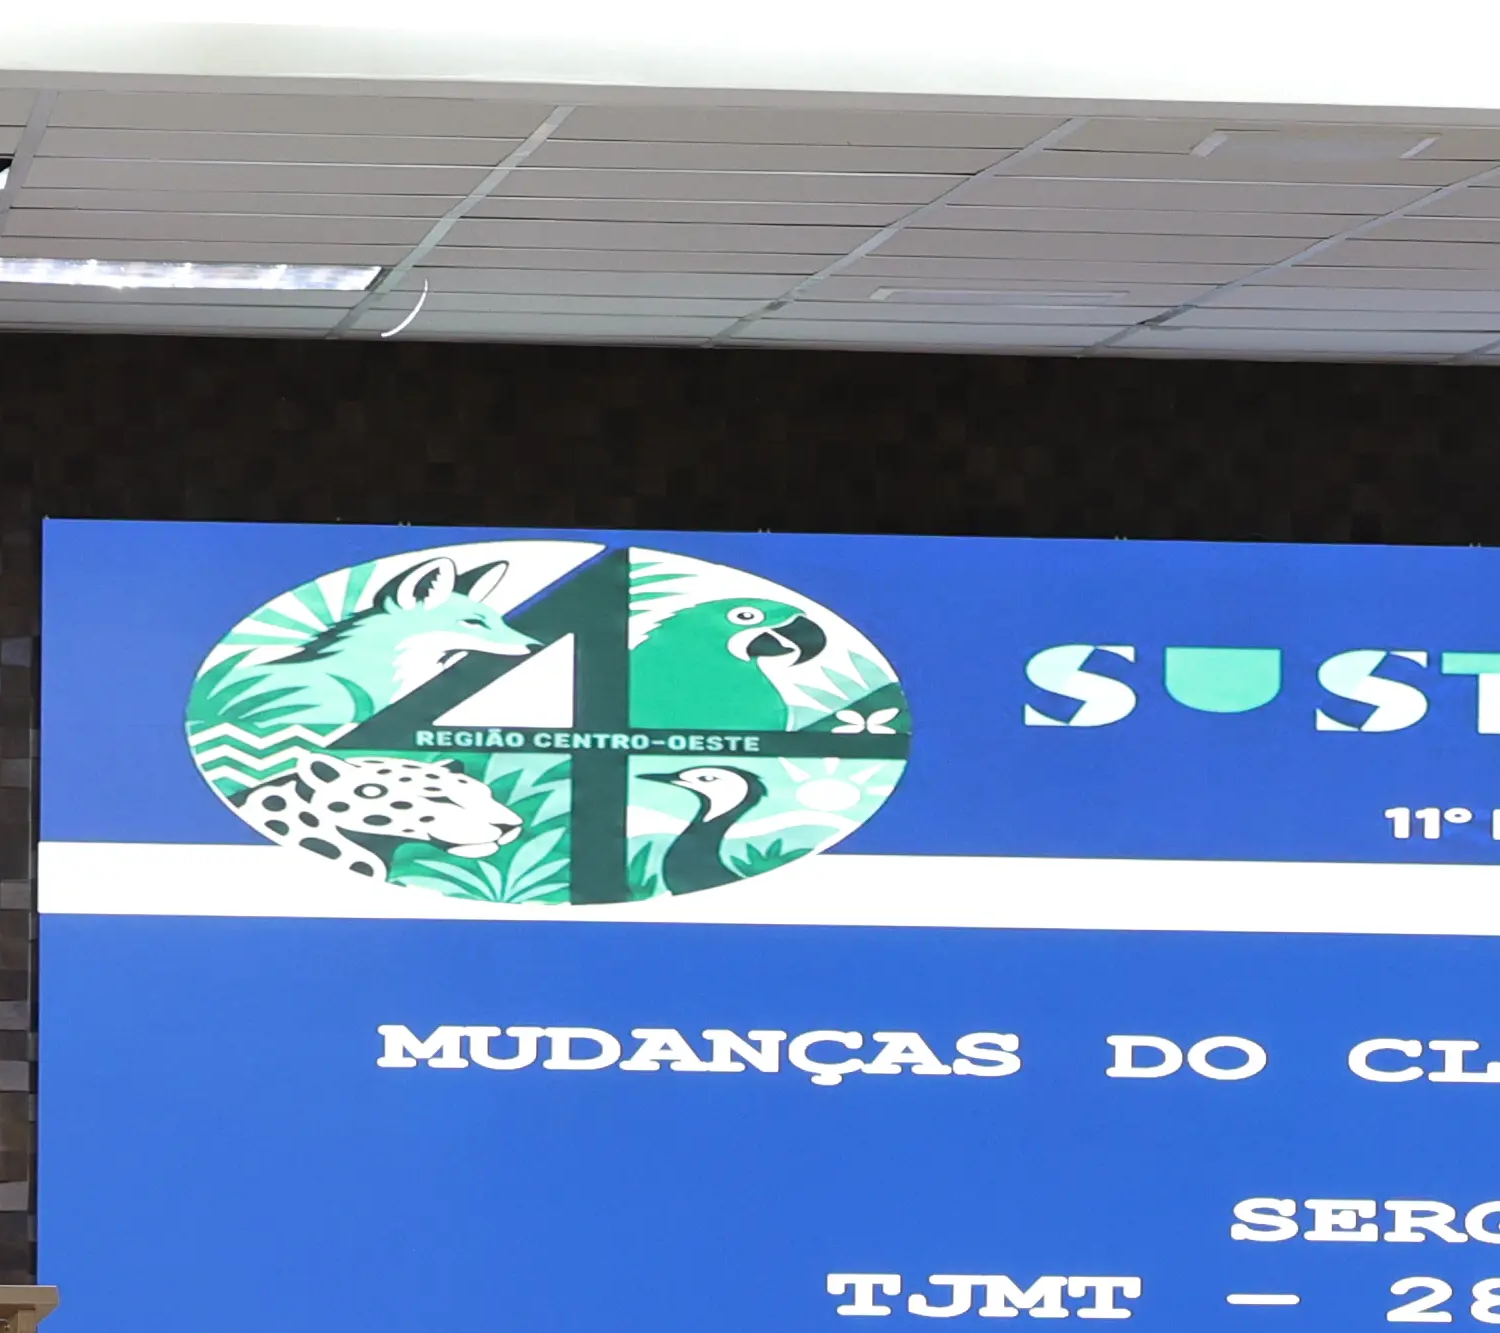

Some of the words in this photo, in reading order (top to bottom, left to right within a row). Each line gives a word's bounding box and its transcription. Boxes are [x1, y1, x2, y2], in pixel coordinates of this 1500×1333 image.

[415, 729, 525, 749] REGIÃO
[534, 732, 761, 752] CENTRO-OESTE
[377, 1025, 1021, 1085] MUDANÇAS
[1106, 1035, 1266, 1080] DO
[827, 1274, 1141, 1318] TJMT
